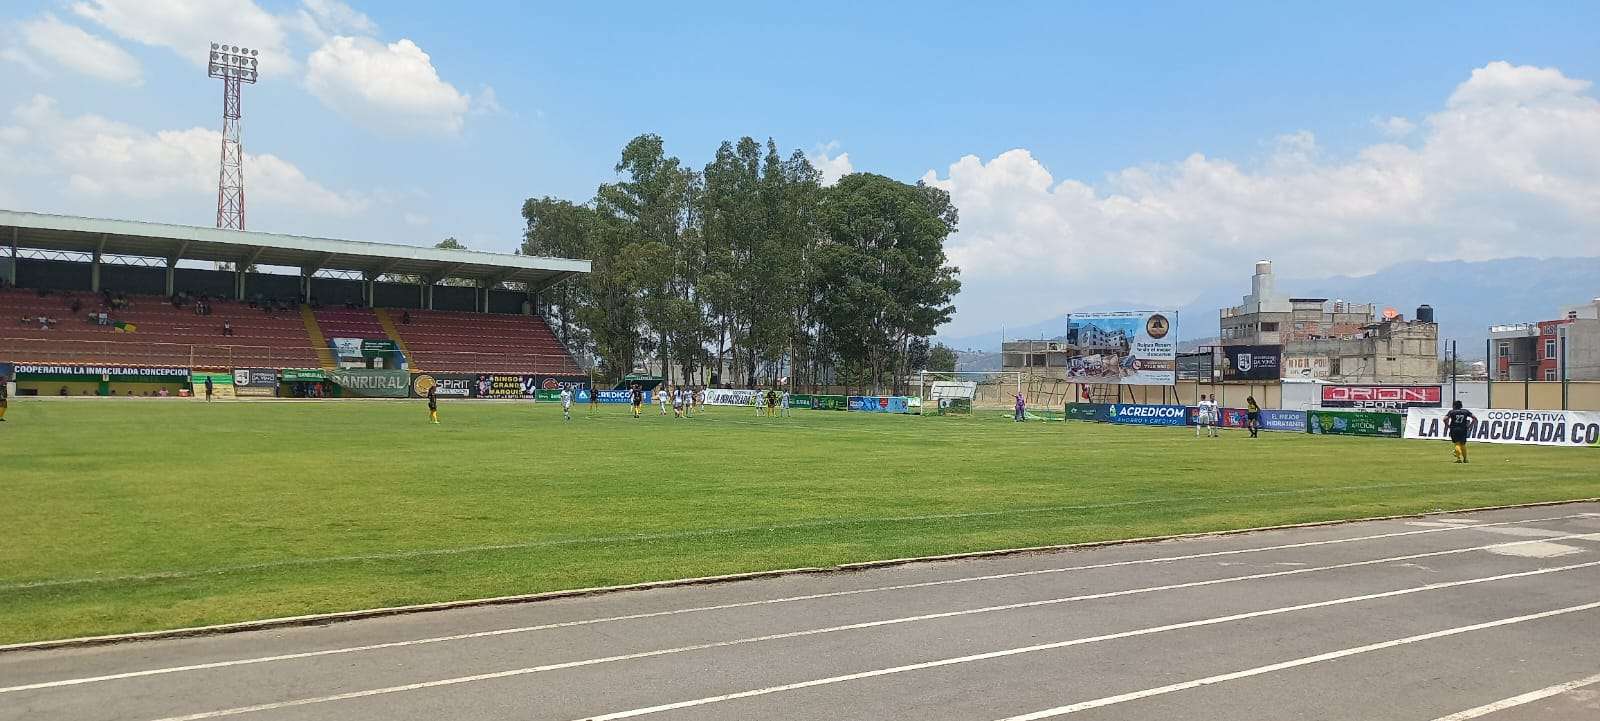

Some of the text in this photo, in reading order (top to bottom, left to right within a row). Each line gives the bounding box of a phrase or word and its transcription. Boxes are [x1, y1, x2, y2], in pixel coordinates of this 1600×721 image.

[14, 365, 188, 376] COOPERATIVA LA INMACULADA CONCEPCION
[1332, 387, 1426, 401] ORION
[1353, 401, 1404, 409] SPORT
[1119, 406, 1184, 418] ACREDICOM
[1488, 411, 1566, 422] COOPERATIVA
[1455, 414, 1465, 424] 27
[1418, 418, 1438, 437] LA
[1443, 418, 1565, 442] IMACULADA
